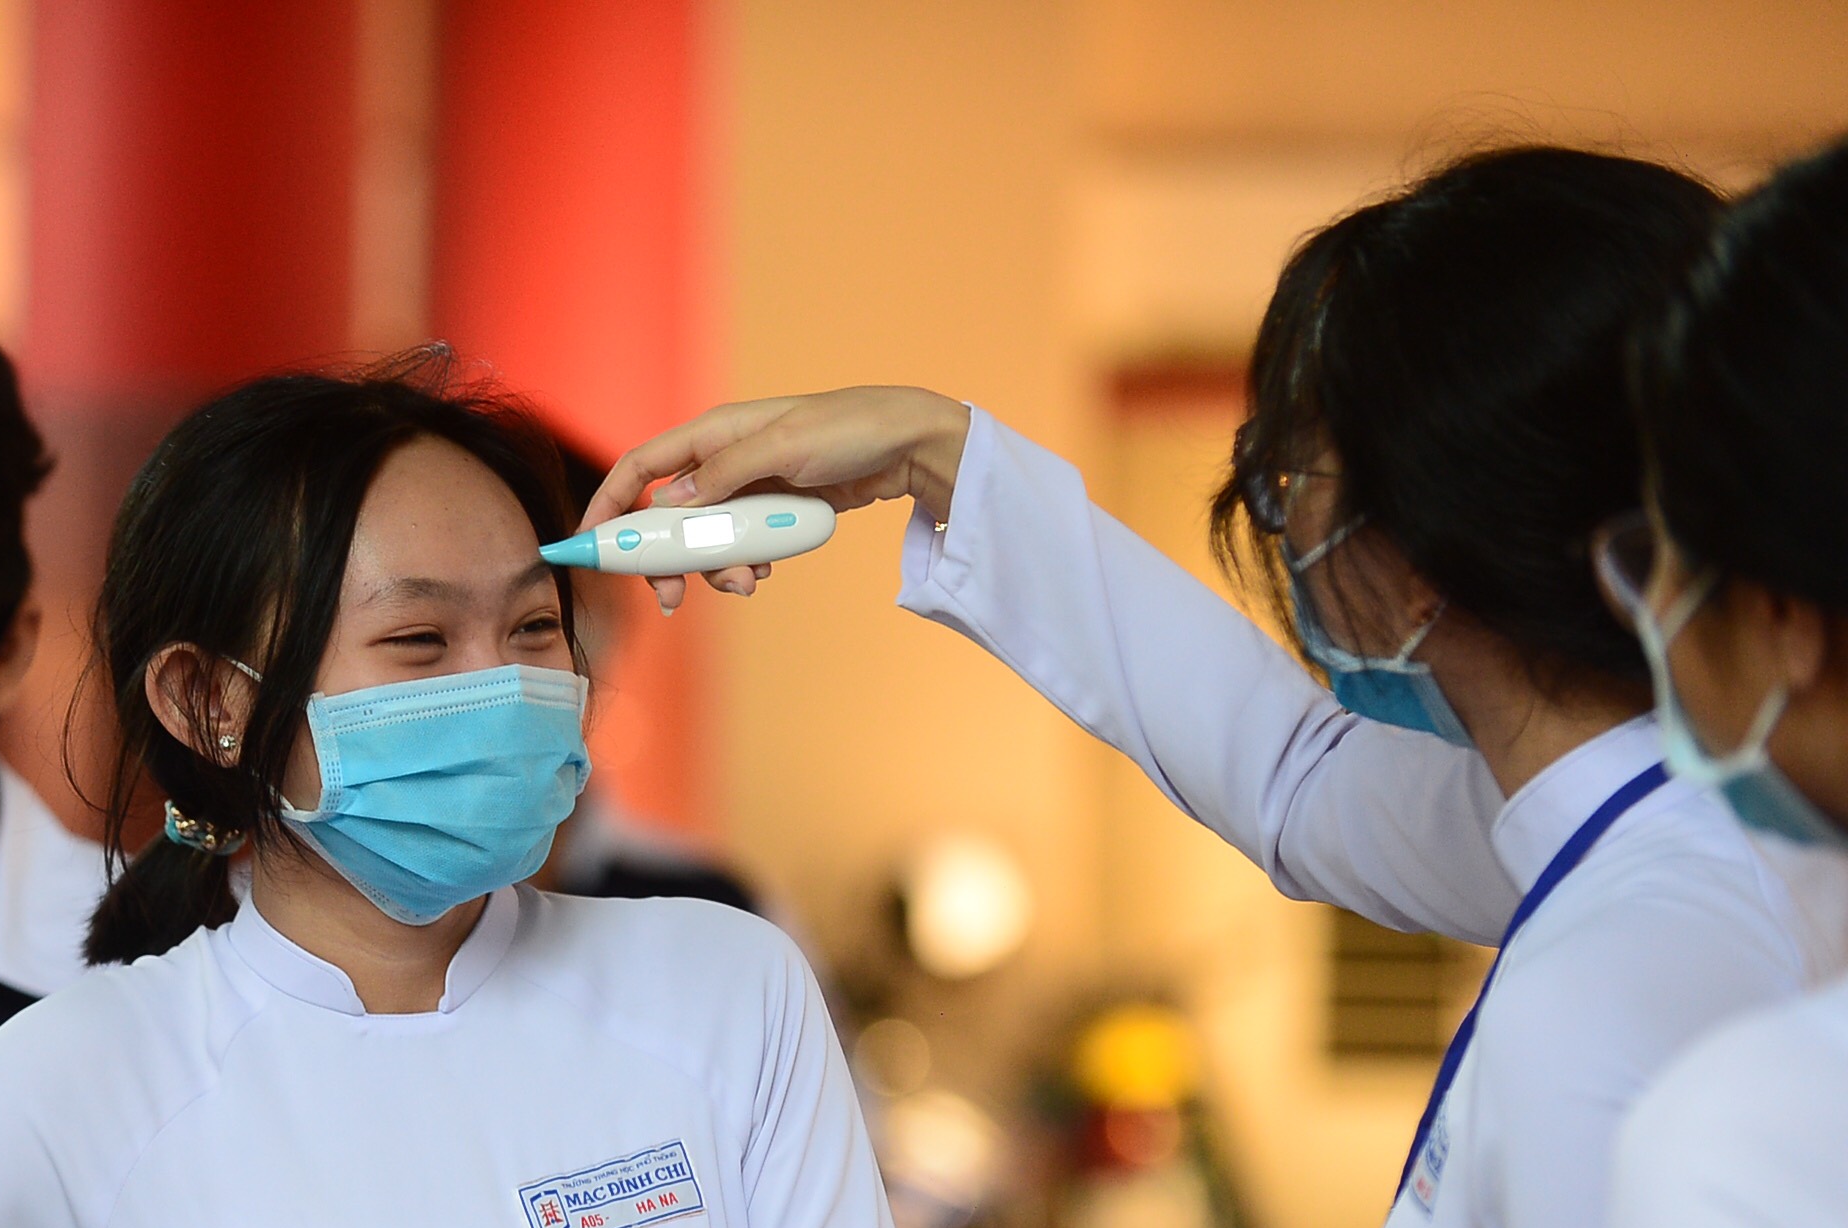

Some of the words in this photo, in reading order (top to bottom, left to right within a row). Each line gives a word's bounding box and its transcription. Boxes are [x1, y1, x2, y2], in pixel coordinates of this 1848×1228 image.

[564, 1186, 607, 1207] MẠC
[654, 1162, 687, 1181] CHI
[636, 1198, 657, 1214] HA
[659, 1192, 679, 1207] NA
